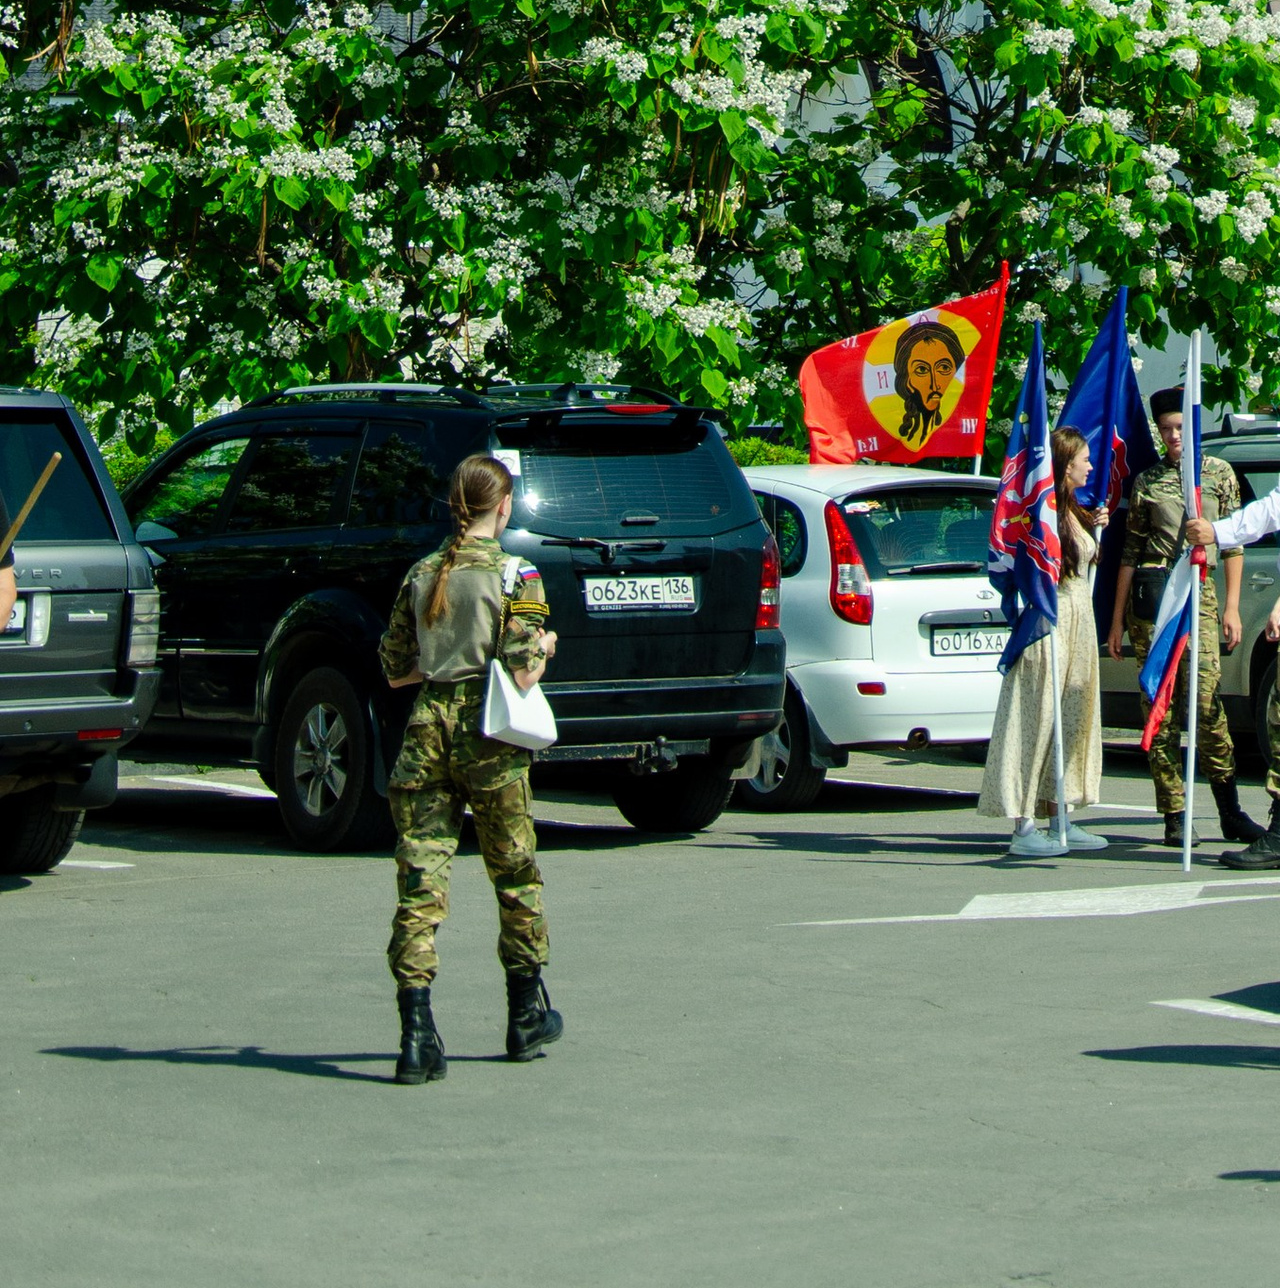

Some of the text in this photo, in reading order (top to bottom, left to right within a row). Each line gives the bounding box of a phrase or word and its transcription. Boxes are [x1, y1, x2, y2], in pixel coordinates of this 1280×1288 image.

[13, 569, 62, 579] VER
[592, 579, 689, 601] О623КЕ 136
